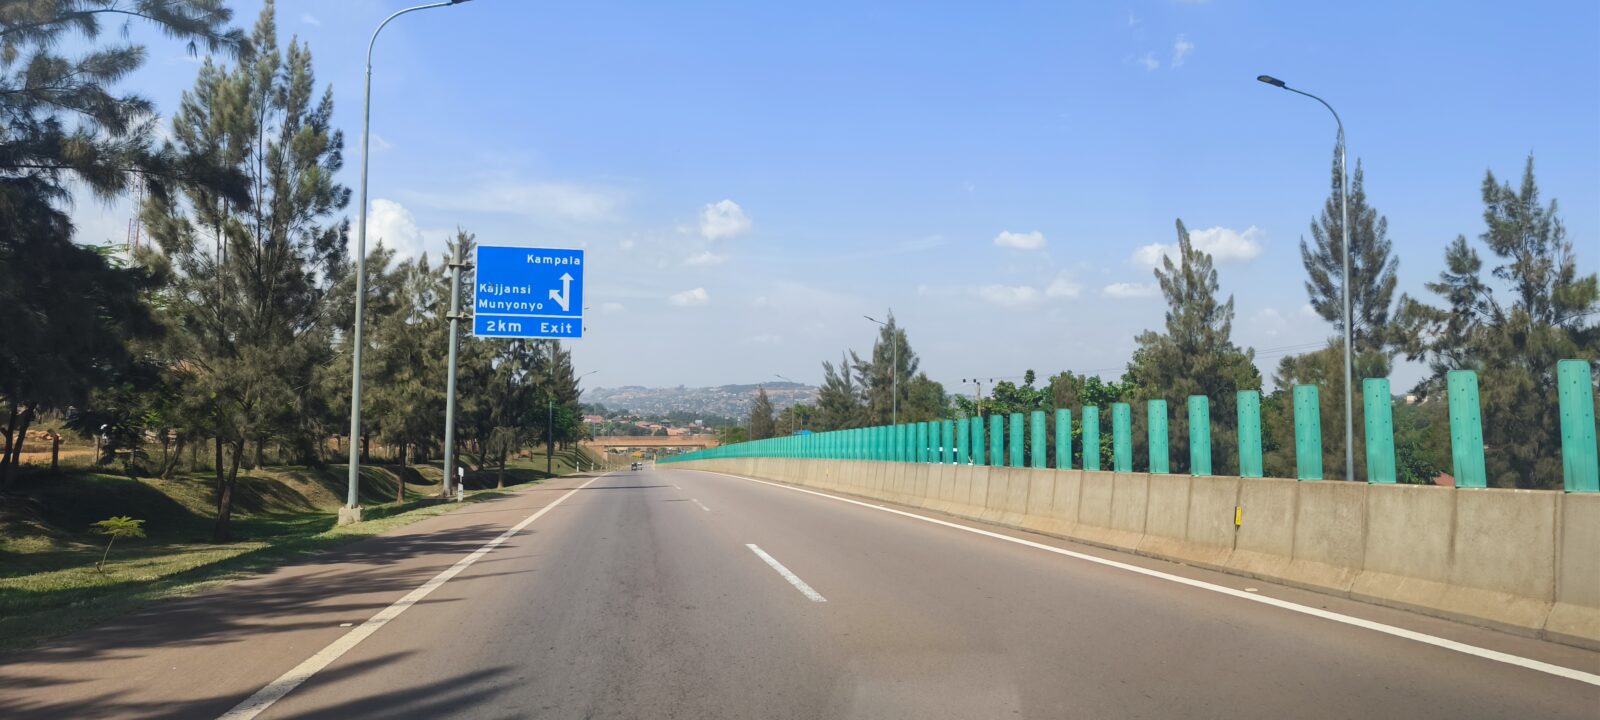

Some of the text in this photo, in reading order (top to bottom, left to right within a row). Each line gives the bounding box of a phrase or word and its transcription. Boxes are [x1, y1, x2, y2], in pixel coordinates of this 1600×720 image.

[527, 254, 581, 266] Kampala
[479, 283, 531, 296] Kajjansi
[479, 299, 543, 311] Munyonyo
[486, 319, 572, 334] 2km Exit
